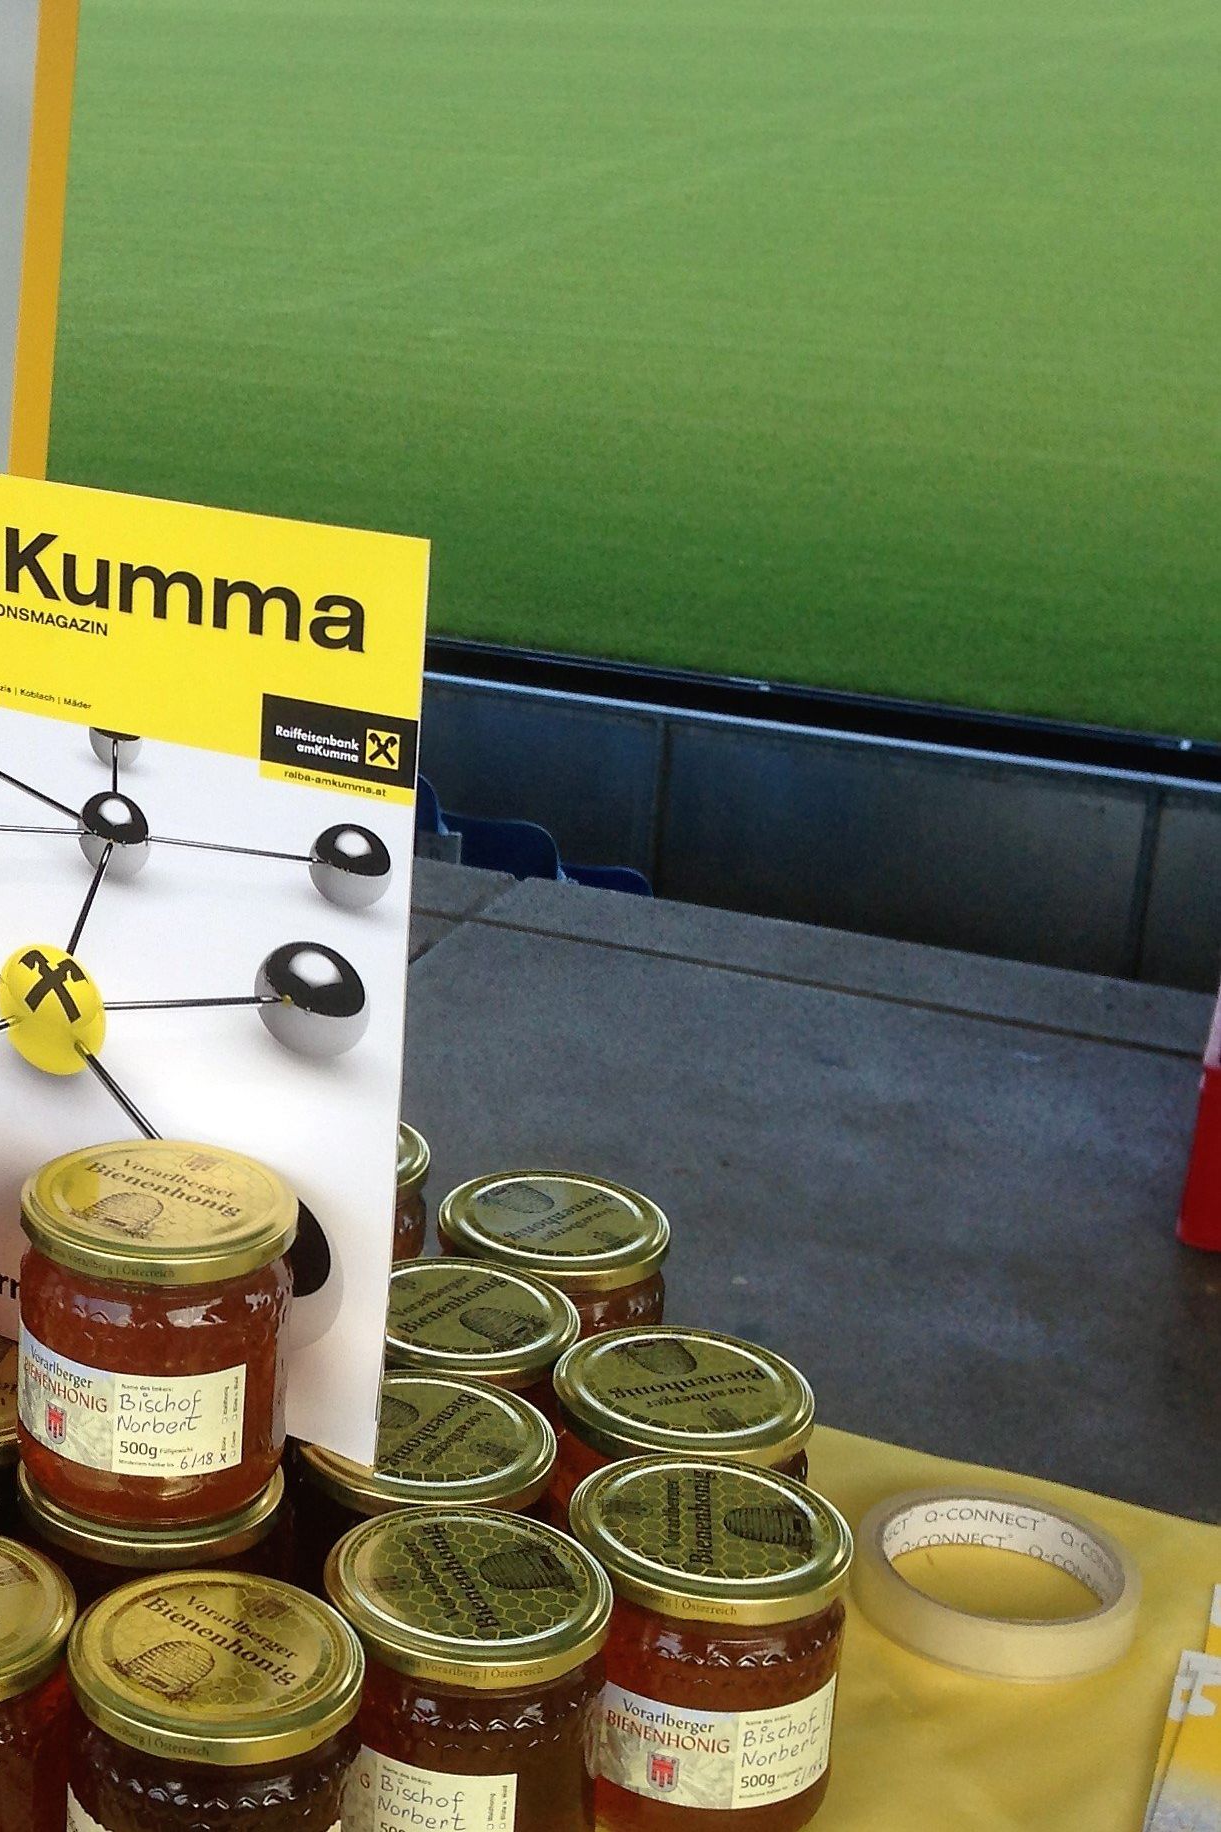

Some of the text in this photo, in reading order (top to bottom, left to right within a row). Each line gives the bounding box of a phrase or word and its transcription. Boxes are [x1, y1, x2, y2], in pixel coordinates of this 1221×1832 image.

[20, 688, 55, 703] Koblach
[64, 698, 92, 711] Mäder
[275, 724, 360, 752] Raiffeisenbank
[296, 742, 359, 764] amKumma
[284, 769, 387, 798] raiba-amkumma.at
[85, 1160, 242, 1218] Bienenhonig
[122, 1158, 238, 1199] Vorarlberger
[122, 1264, 175, 1278] Österreich
[397, 1274, 509, 1334] Bienenhonig
[30, 1344, 94, 1389] Vorarlberger
[607, 1368, 766, 1400] Bienenhonig
[645, 1384, 761, 1409] Vorarlberger
[119, 1390, 202, 1416] Bischof
[116, 1415, 203, 1435] Norbert
[119, 1440, 158, 1459] 500g
[689, 1467, 718, 1566] Bienenhonig
[681, 1600, 738, 1618] Österreich
[143, 1595, 299, 1686] Bienenhonig
[186, 1594, 299, 1660] Vorarlberger
[424, 1660, 480, 1681] Vorarlberg
[490, 1663, 545, 1680] Österreich
[606, 1708, 731, 1754] BIENENHONIG
[622, 1697, 716, 1736] Vorarlberger
[743, 1706, 818, 1748] Bischof
[153, 1735, 210, 1758] Österreich
[741, 1726, 820, 1768] Norbert
[380, 1774, 465, 1813] Bischof
[740, 1773, 777, 1790] 500g
[377, 1795, 467, 1831] Norbert
